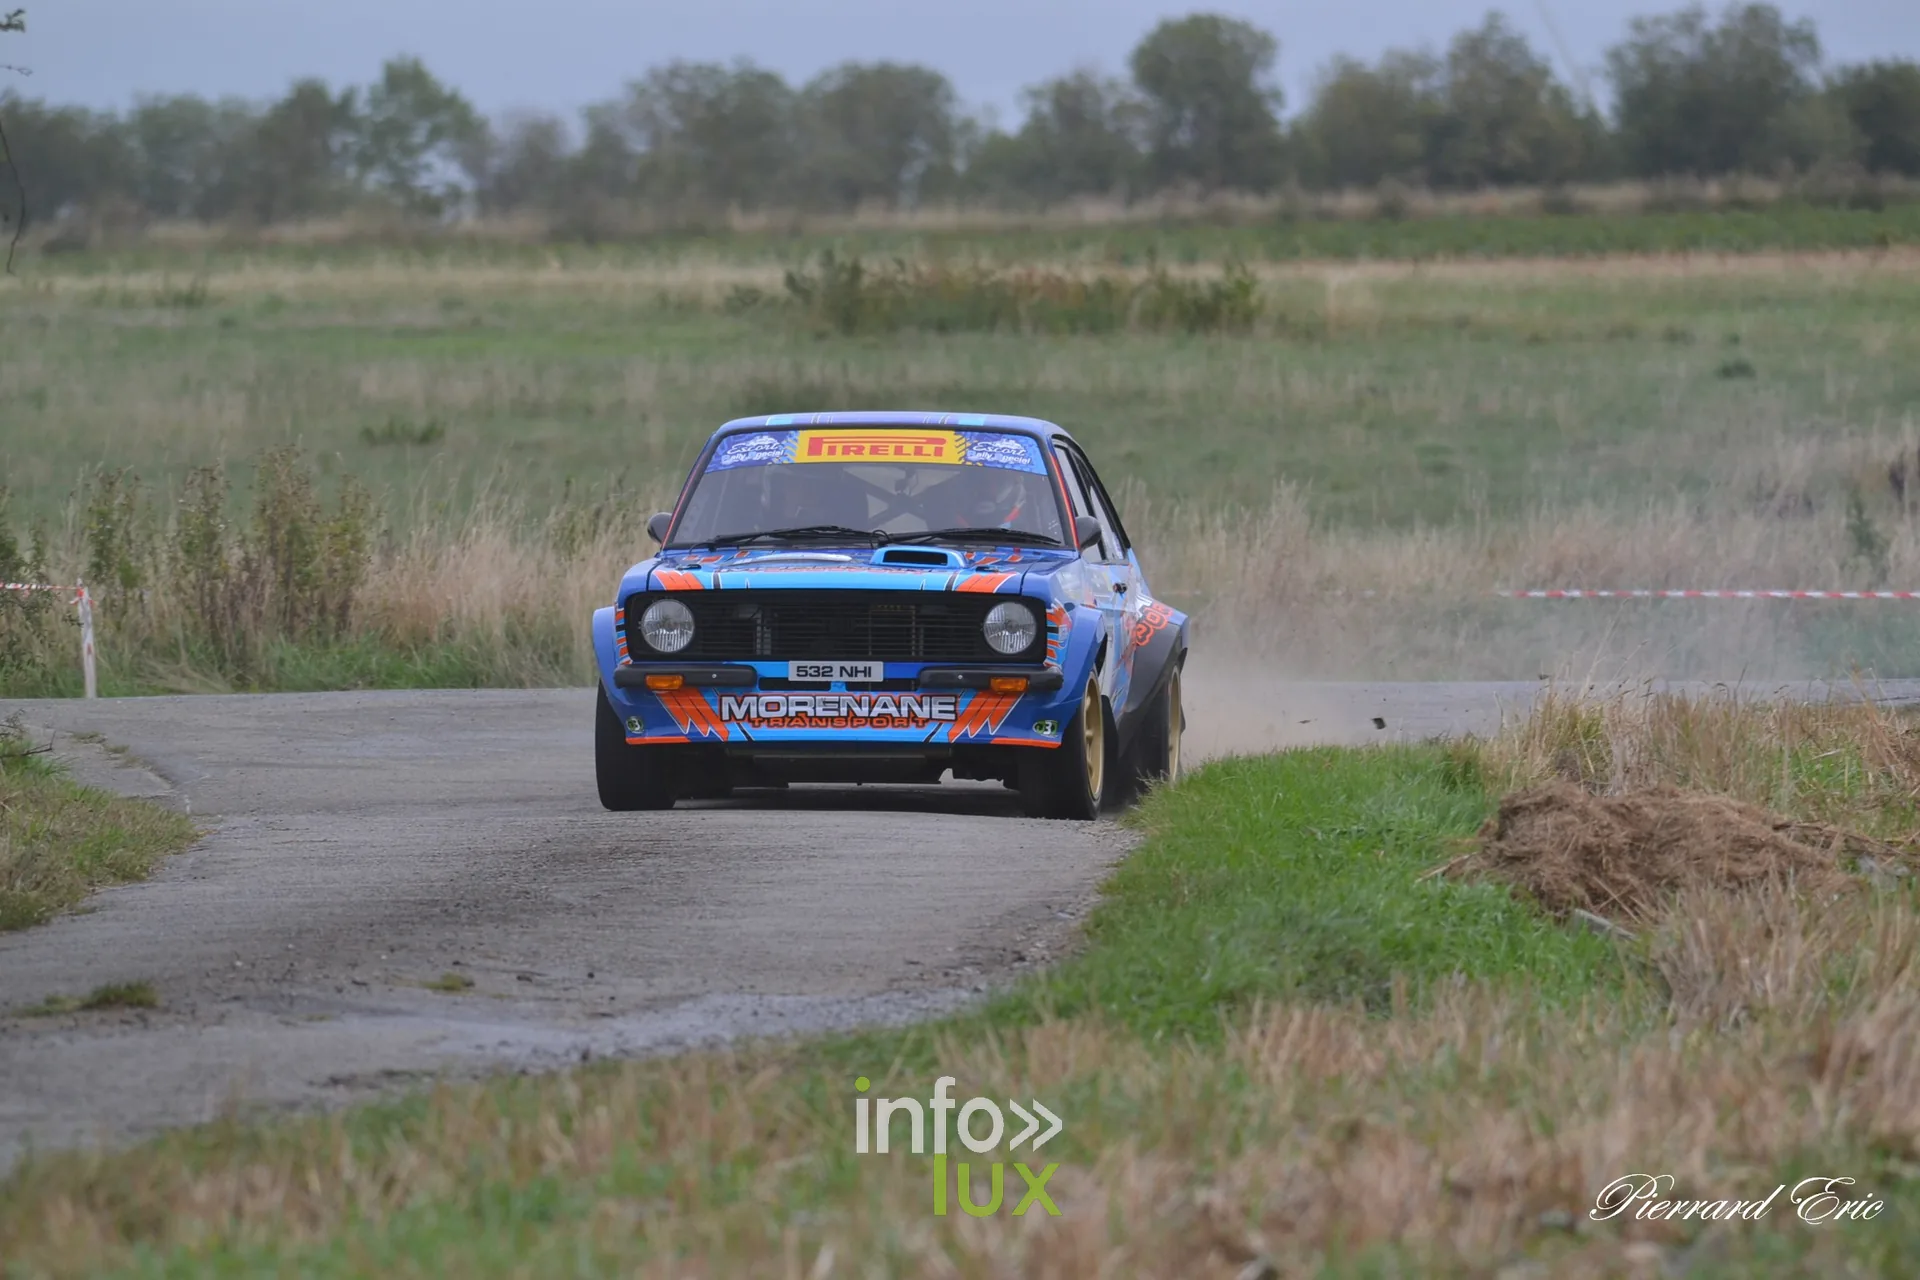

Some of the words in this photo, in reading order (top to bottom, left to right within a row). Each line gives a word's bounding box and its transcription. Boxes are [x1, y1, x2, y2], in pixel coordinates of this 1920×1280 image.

[726, 442, 780, 455] Escort
[807, 436, 946, 457] PIRELLI
[972, 442, 1027, 456] Escort
[796, 665, 833, 678] 532
[839, 666, 872, 678] NHI
[721, 695, 956, 720] MORENANE
[751, 717, 927, 728] TRANSPORT
